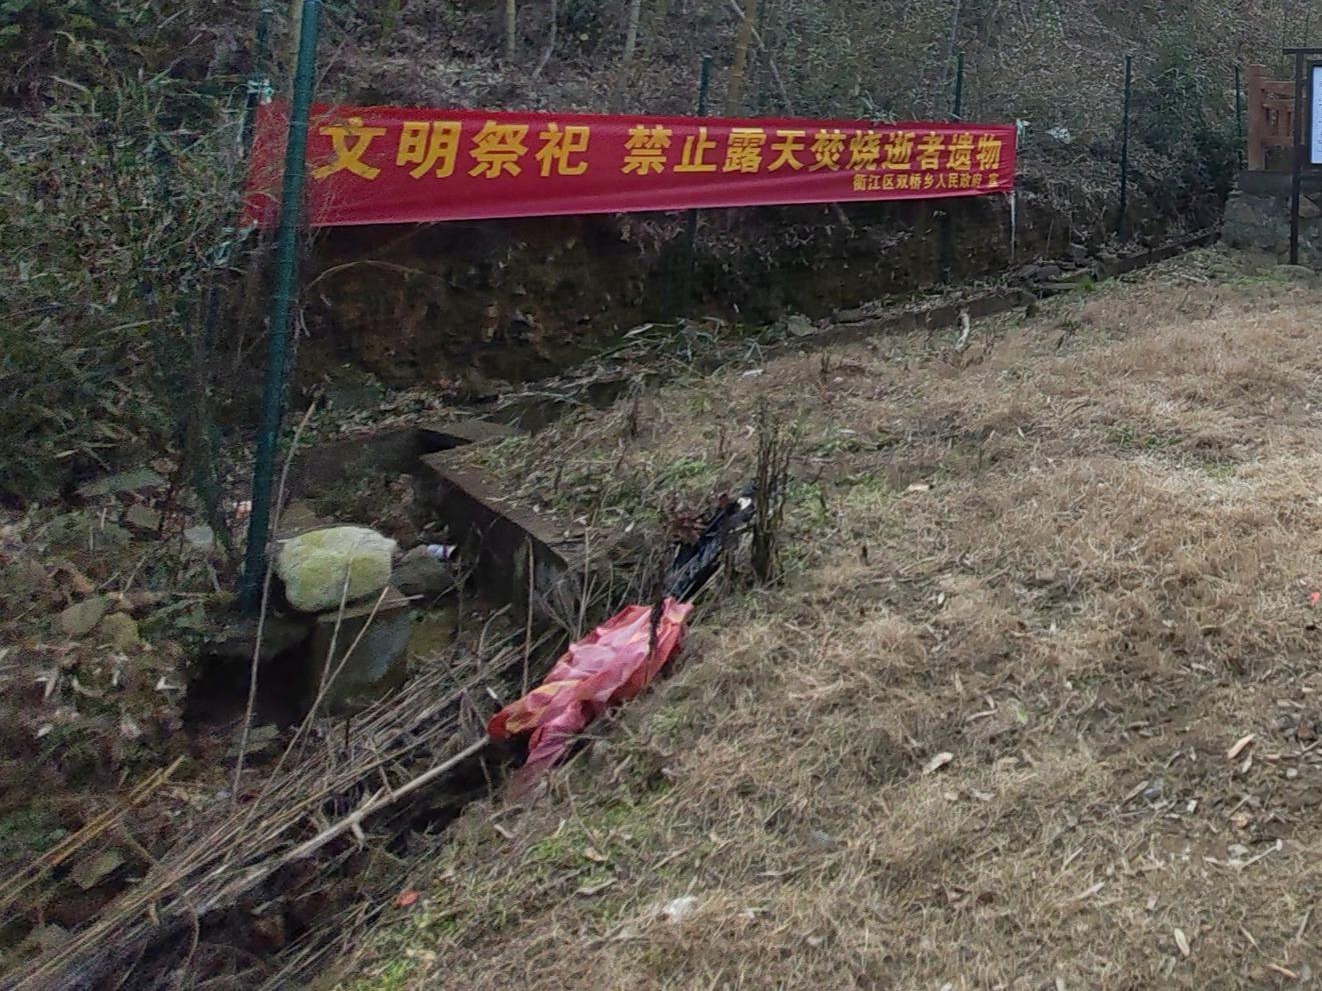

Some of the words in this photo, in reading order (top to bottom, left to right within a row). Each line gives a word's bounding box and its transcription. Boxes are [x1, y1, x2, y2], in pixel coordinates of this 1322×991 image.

[311, 117, 590, 180] 文明祭祀
[621, 123, 1002, 175] 禁止露天焚烧逝者遗物
[852, 172, 983, 191] 衢江区双桥乡人民政府
